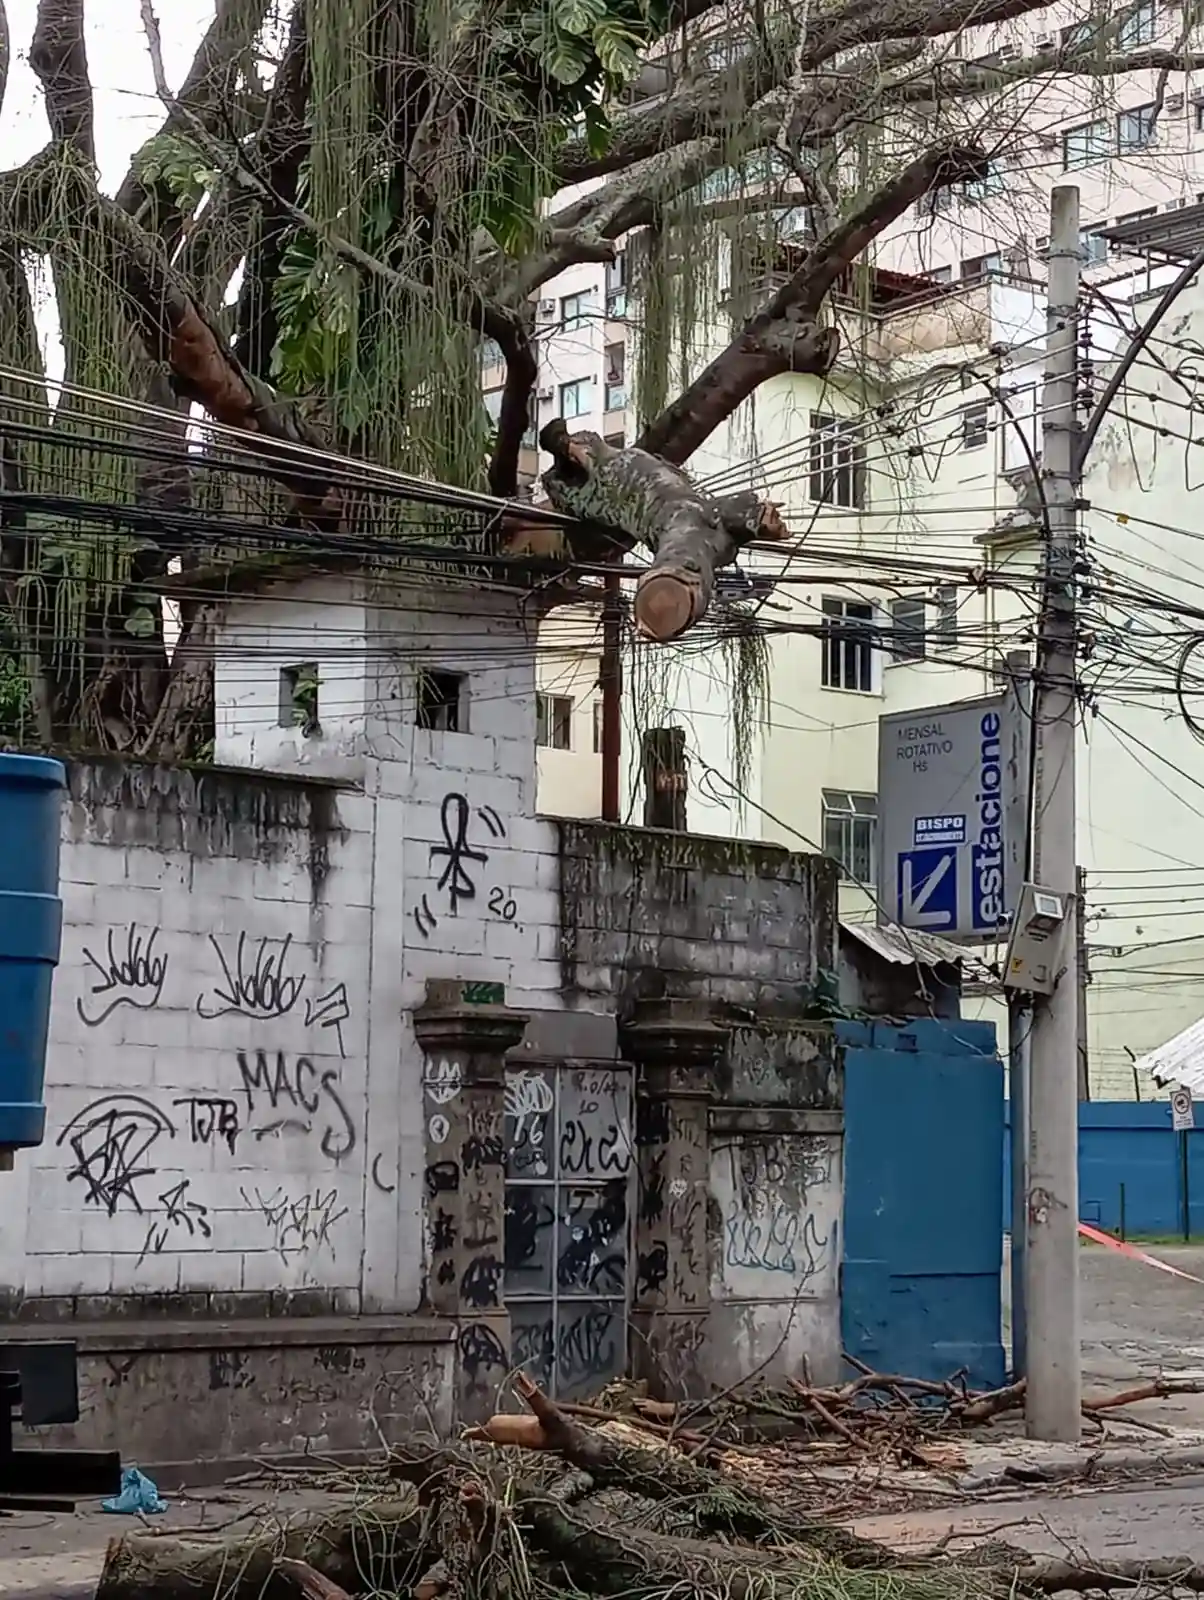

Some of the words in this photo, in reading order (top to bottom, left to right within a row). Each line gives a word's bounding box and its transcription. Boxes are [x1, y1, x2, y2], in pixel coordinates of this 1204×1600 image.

[898, 722, 946, 741] MENSAL
[897, 740, 953, 760] ROTATIVO
[917, 817, 963, 830] BISPO
[976, 712, 1002, 923] estacione
